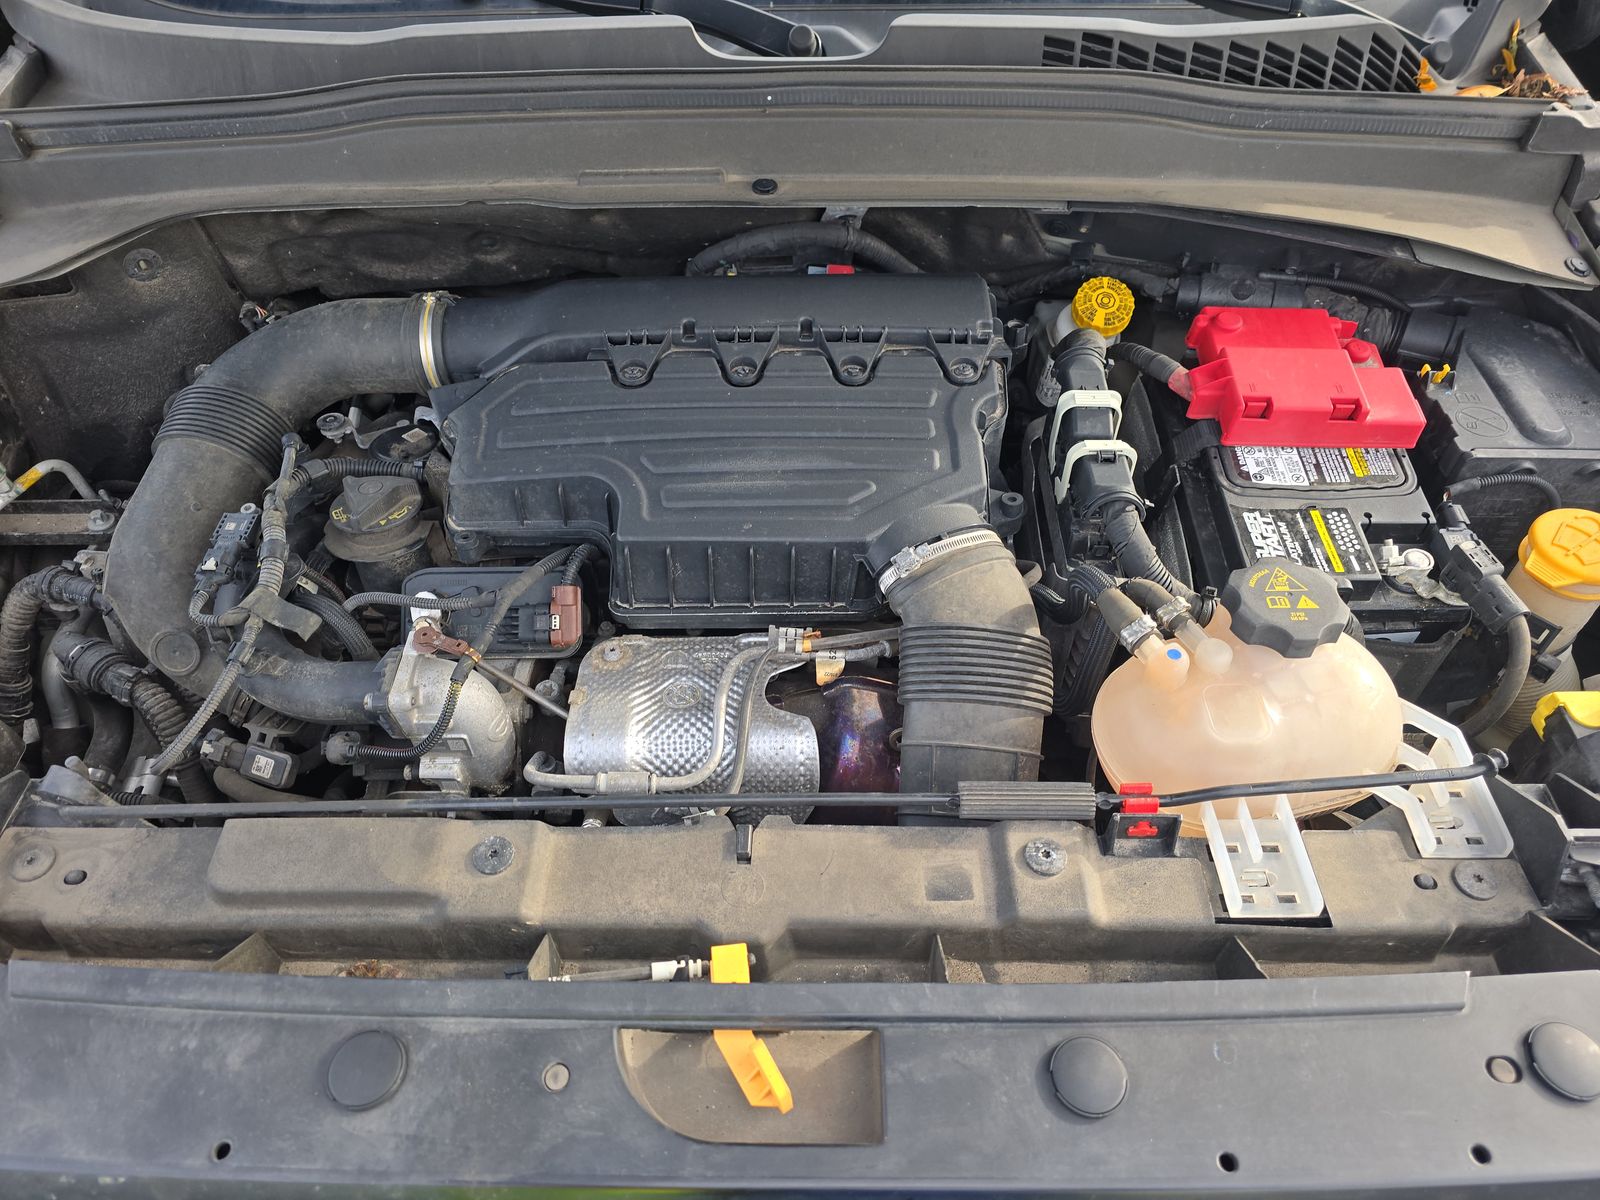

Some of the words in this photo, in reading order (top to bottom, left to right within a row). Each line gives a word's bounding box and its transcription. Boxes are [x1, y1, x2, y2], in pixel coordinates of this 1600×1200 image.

[1235, 446, 1246, 464] DANG
[1255, 511, 1285, 557] TART
[1277, 521, 1302, 565] LATINUM
